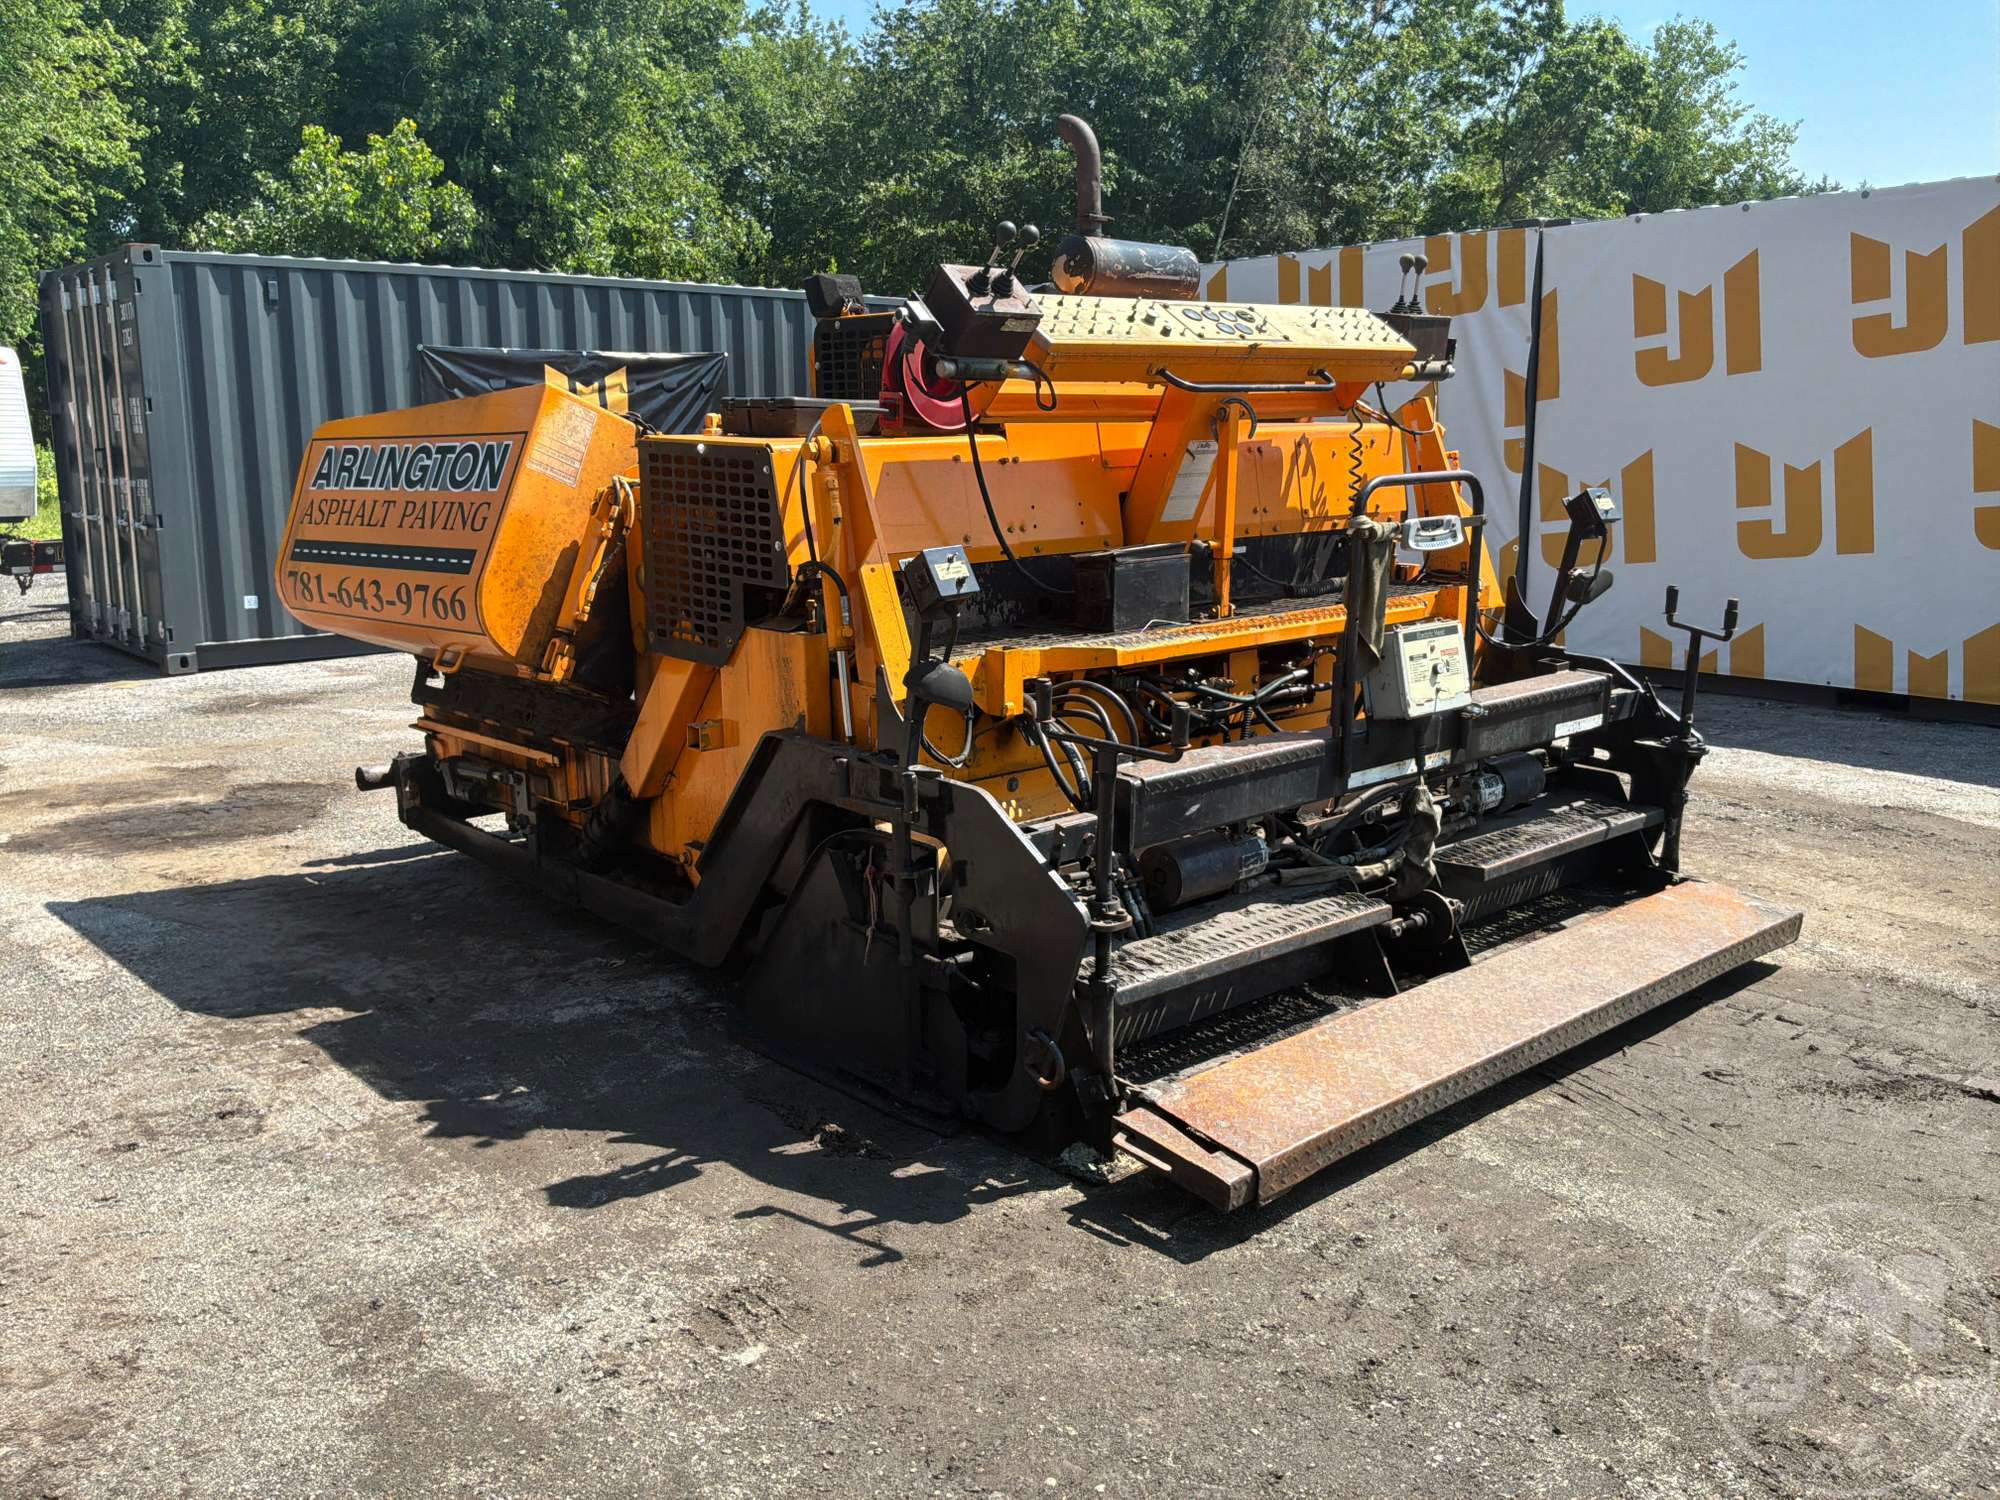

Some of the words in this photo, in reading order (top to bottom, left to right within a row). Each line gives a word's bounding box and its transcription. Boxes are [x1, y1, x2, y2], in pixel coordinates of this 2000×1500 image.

[309, 441, 512, 493] ARLINGTON
[300, 498, 397, 528] ASPHALT
[398, 500, 491, 532] PAVING
[287, 570, 468, 622] 781-643-9766
